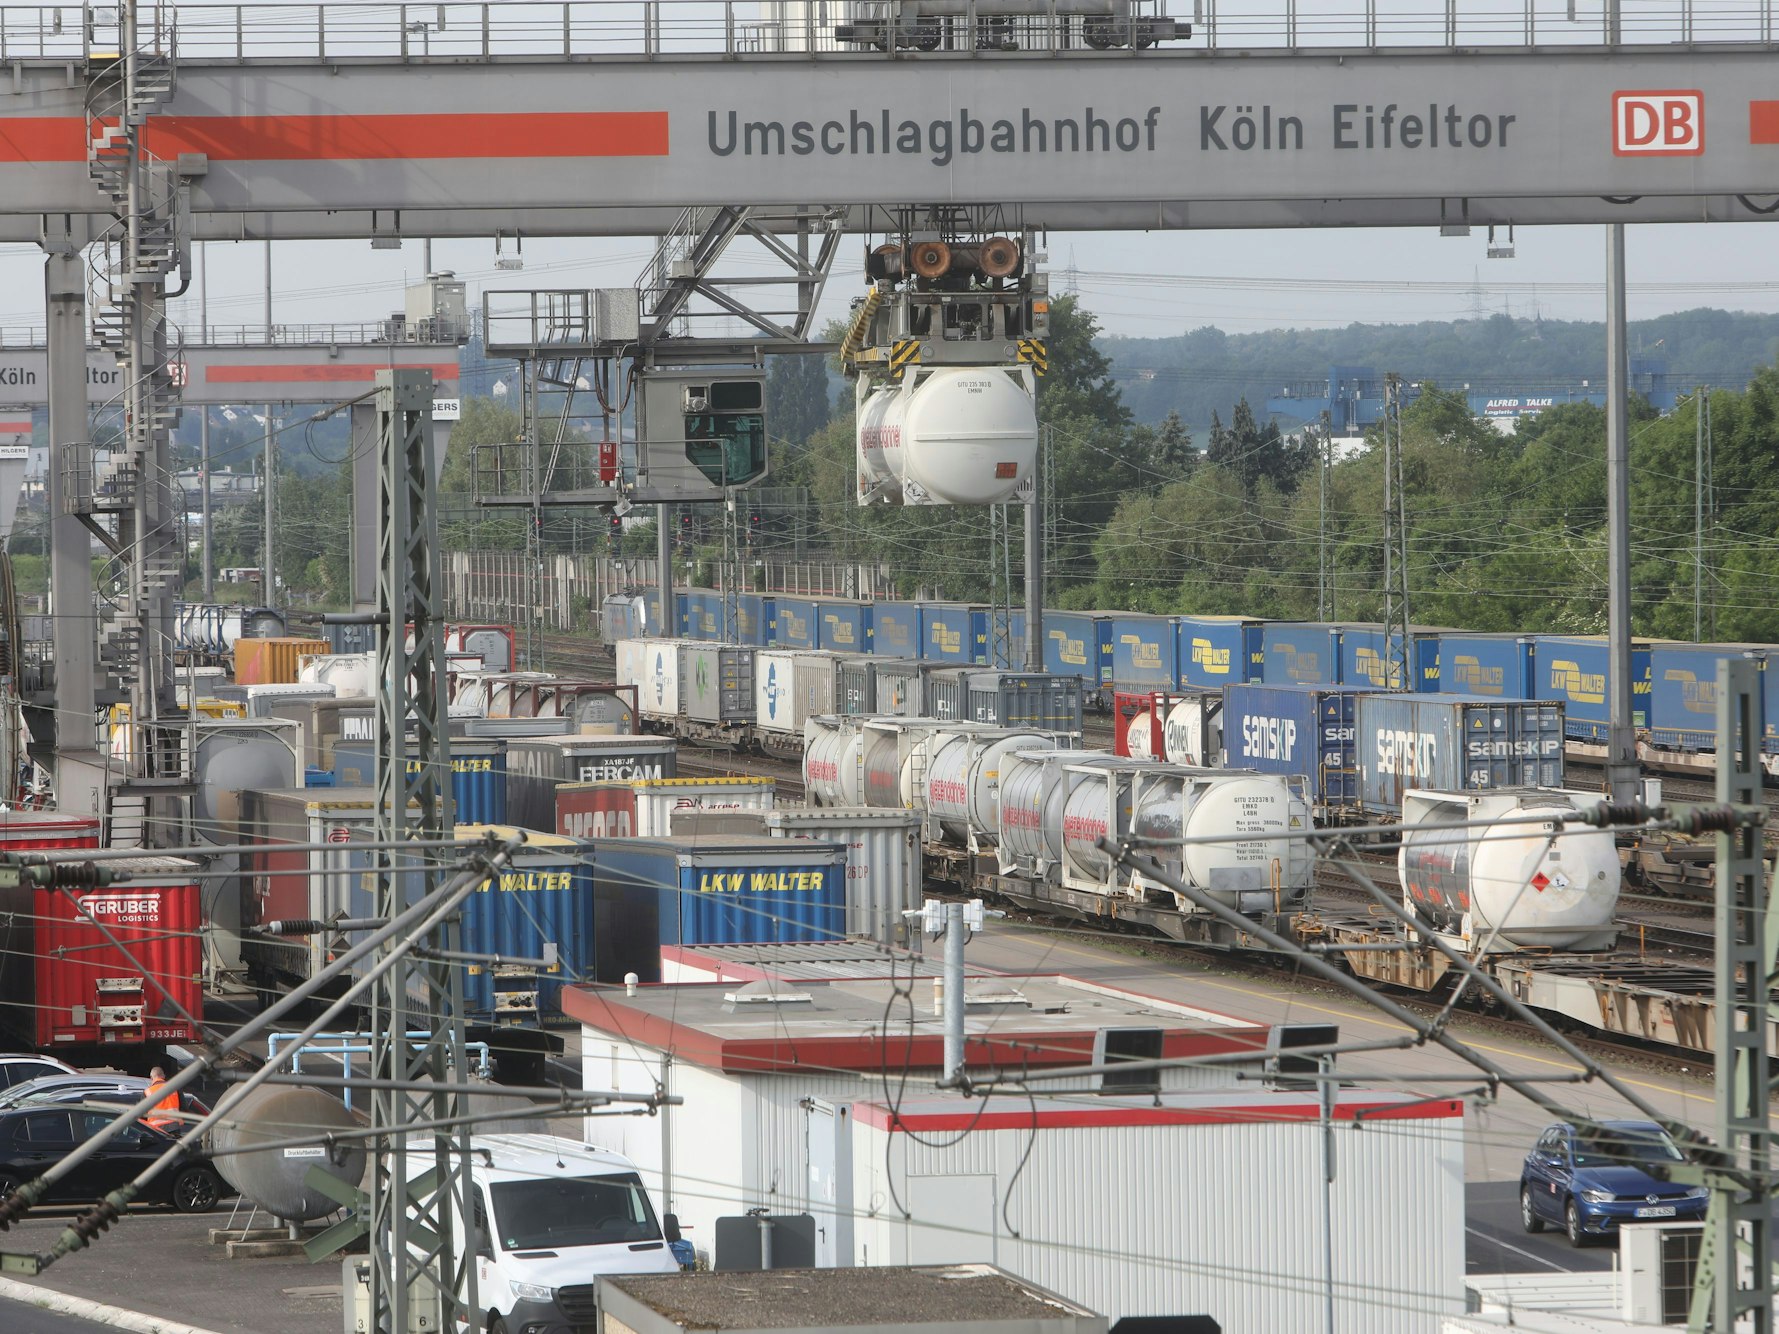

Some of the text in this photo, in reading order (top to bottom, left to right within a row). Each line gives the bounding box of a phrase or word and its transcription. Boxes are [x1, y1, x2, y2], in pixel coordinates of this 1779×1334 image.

[1624, 100, 1695, 146] DB
[707, 103, 1516, 167] Umschlagbahnhof Köln Eifeltor
[0, 368, 36, 385] Köln
[86, 367, 119, 384] ltor
[432, 403, 458, 411] GERS
[1487, 398, 1553, 408] ALFRED TALKE
[1212, 648, 1230, 665] WALTER
[1480, 667, 1504, 685] WALTER
[1551, 671, 1606, 694] LKW WALTER
[406, 759, 492, 773] LK ALTER
[604, 757, 635, 766] XA187JF
[1324, 752, 1341, 766] 45
[580, 764, 662, 782] FERCAM
[1470, 769, 1489, 784] 45
[500, 872, 572, 892] WALTER
[700, 872, 824, 893] LKW WALTER
[95, 900, 159, 914] GRUBER
[358, 1319, 364, 1329] 3
[419, 1316, 427, 1326] 6
